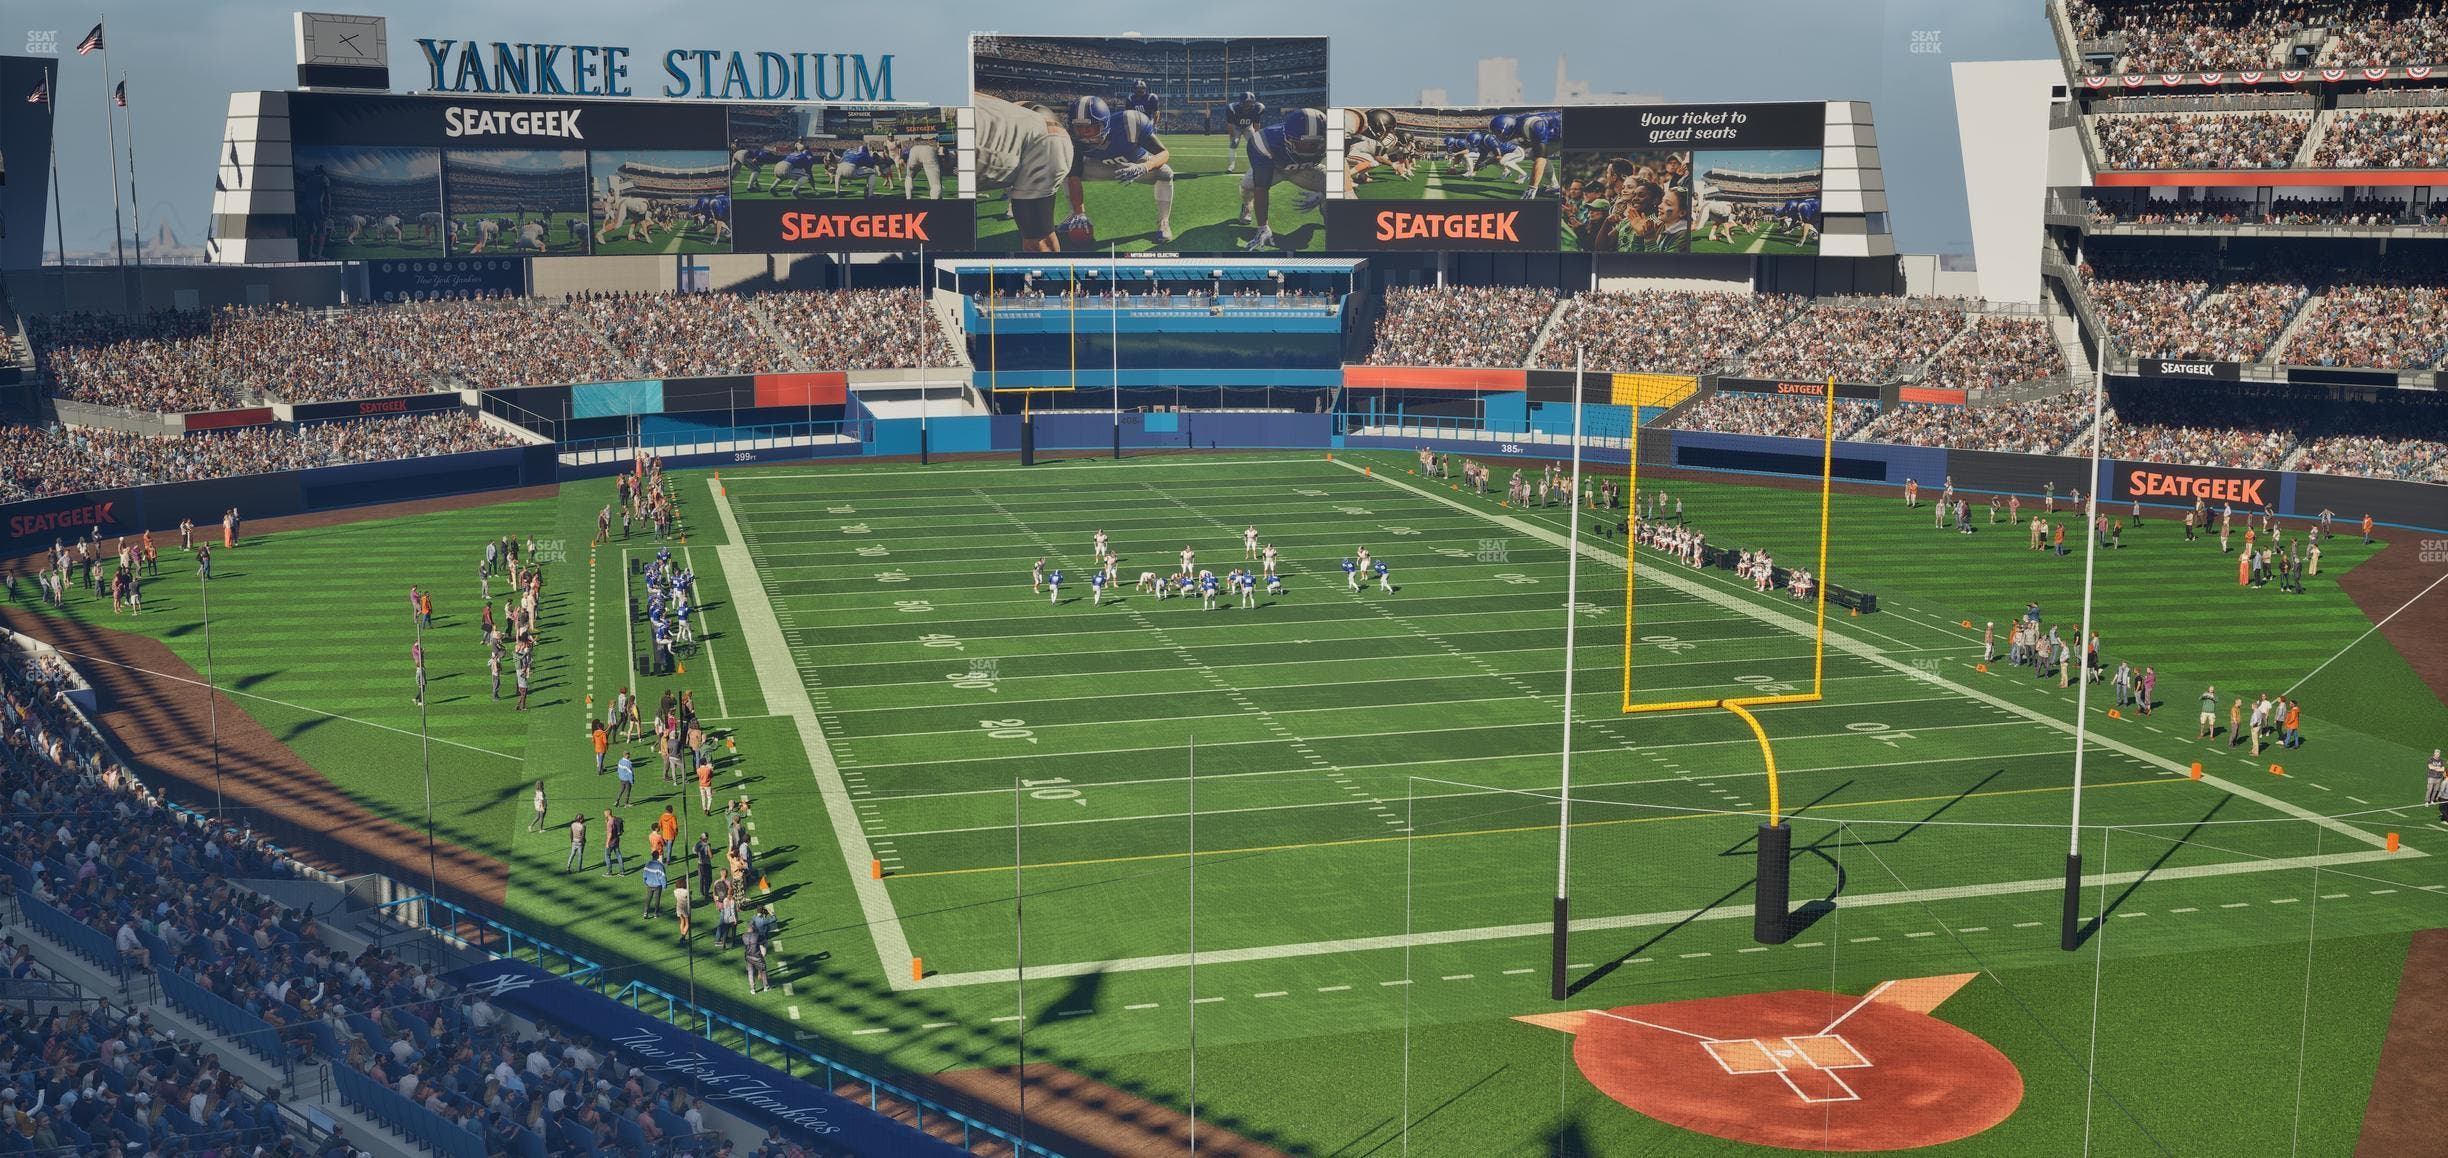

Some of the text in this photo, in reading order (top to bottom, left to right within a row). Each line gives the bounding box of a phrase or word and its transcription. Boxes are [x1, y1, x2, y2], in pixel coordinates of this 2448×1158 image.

[416, 38, 896, 101] YANKEE STADIUM
[445, 106, 584, 140] SEATGEEK
[1641, 111, 1747, 127] Your ticket to
[1649, 126, 1737, 143] great seats
[781, 211, 930, 241] SEATGEEK
[1376, 210, 1520, 243] SEATGEEK
[2161, 362, 2215, 376] SEATGEEK
[1777, 382, 1825, 396] SEATGEEK
[360, 399, 407, 414] SEATGEEK
[2129, 470, 2265, 506] SEATGEEK
[10, 501, 116, 538] SEATGEEK
[894, 600, 934, 613] 50
[918, 633, 962, 648] 40
[945, 672, 995, 689] 30
[1733, 675, 1800, 692] 20
[979, 718, 1034, 739] 20
[1844, 722, 1918, 740] 10
[1021, 776, 1082, 800] 10
[611, 1027, 841, 1135] New York Yankees
